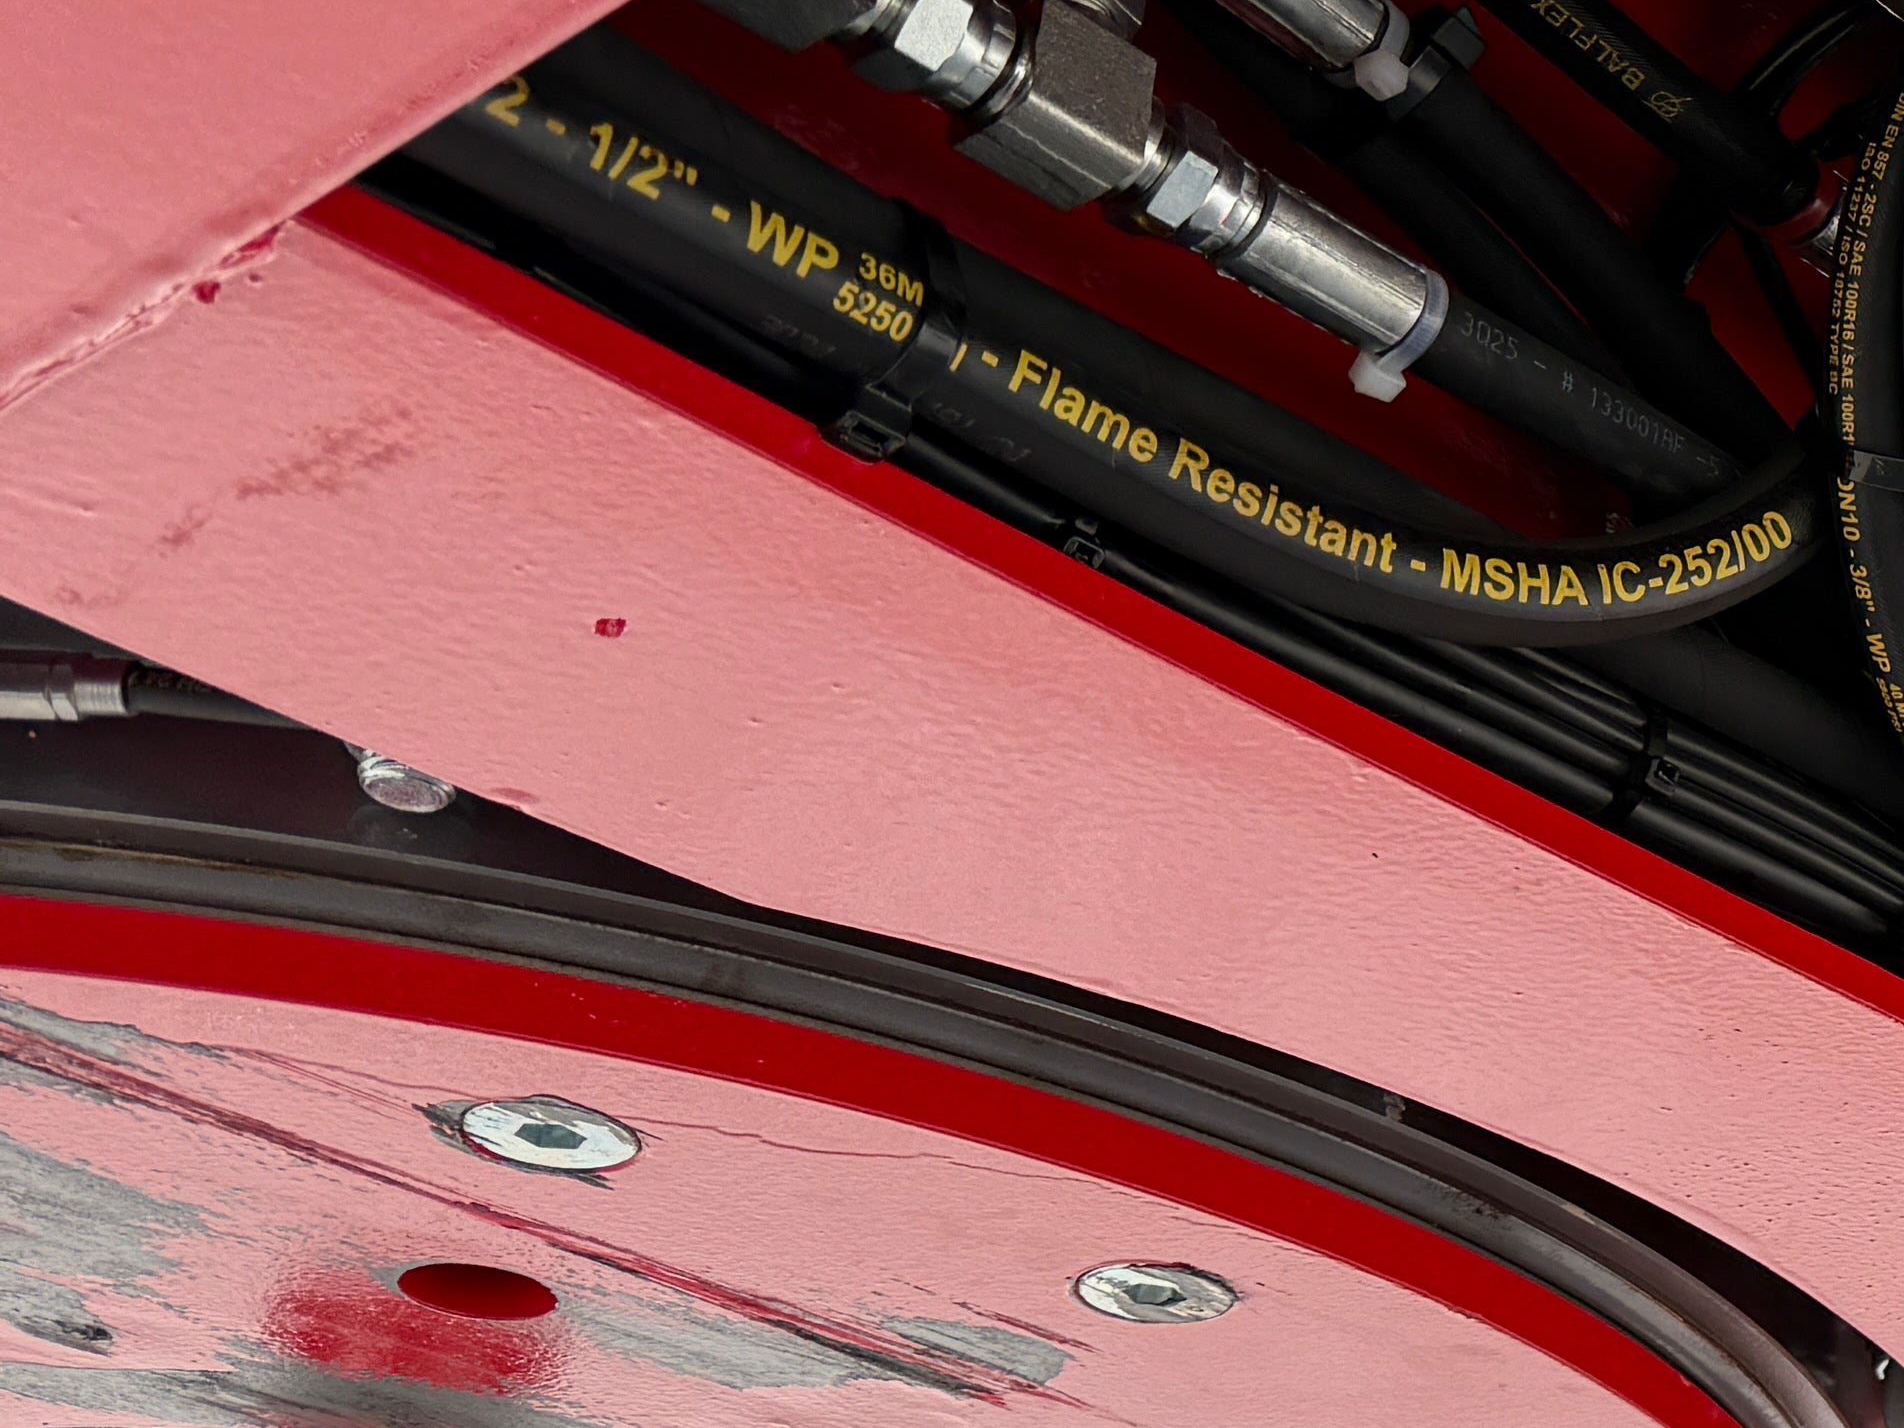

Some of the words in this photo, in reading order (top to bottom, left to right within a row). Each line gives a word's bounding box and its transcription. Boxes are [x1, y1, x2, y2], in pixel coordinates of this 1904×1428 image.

[1882, 125, 1900, 149] EN
[1871, 150, 1891, 180] 857
[1860, 190, 1878, 227] 2SC
[1850, 241, 1867, 277] SAE
[833, 282, 915, 342] 5250
[1841, 281, 1860, 342] 100R16
[590, 123, 698, 200] 1/2"
[747, 200, 840, 278] WP
[858, 252, 925, 307] 36M
[1008, 350, 1159, 463] Flame
[1169, 437, 1397, 574] Resistant
[1440, 548, 1589, 606] MSHA
[1600, 512, 1793, 606] IC-252/00
[1841, 354, 1856, 391] SAE
[1840, 393, 1856, 443] 100R1
[1865, 632, 1892, 674] WP
